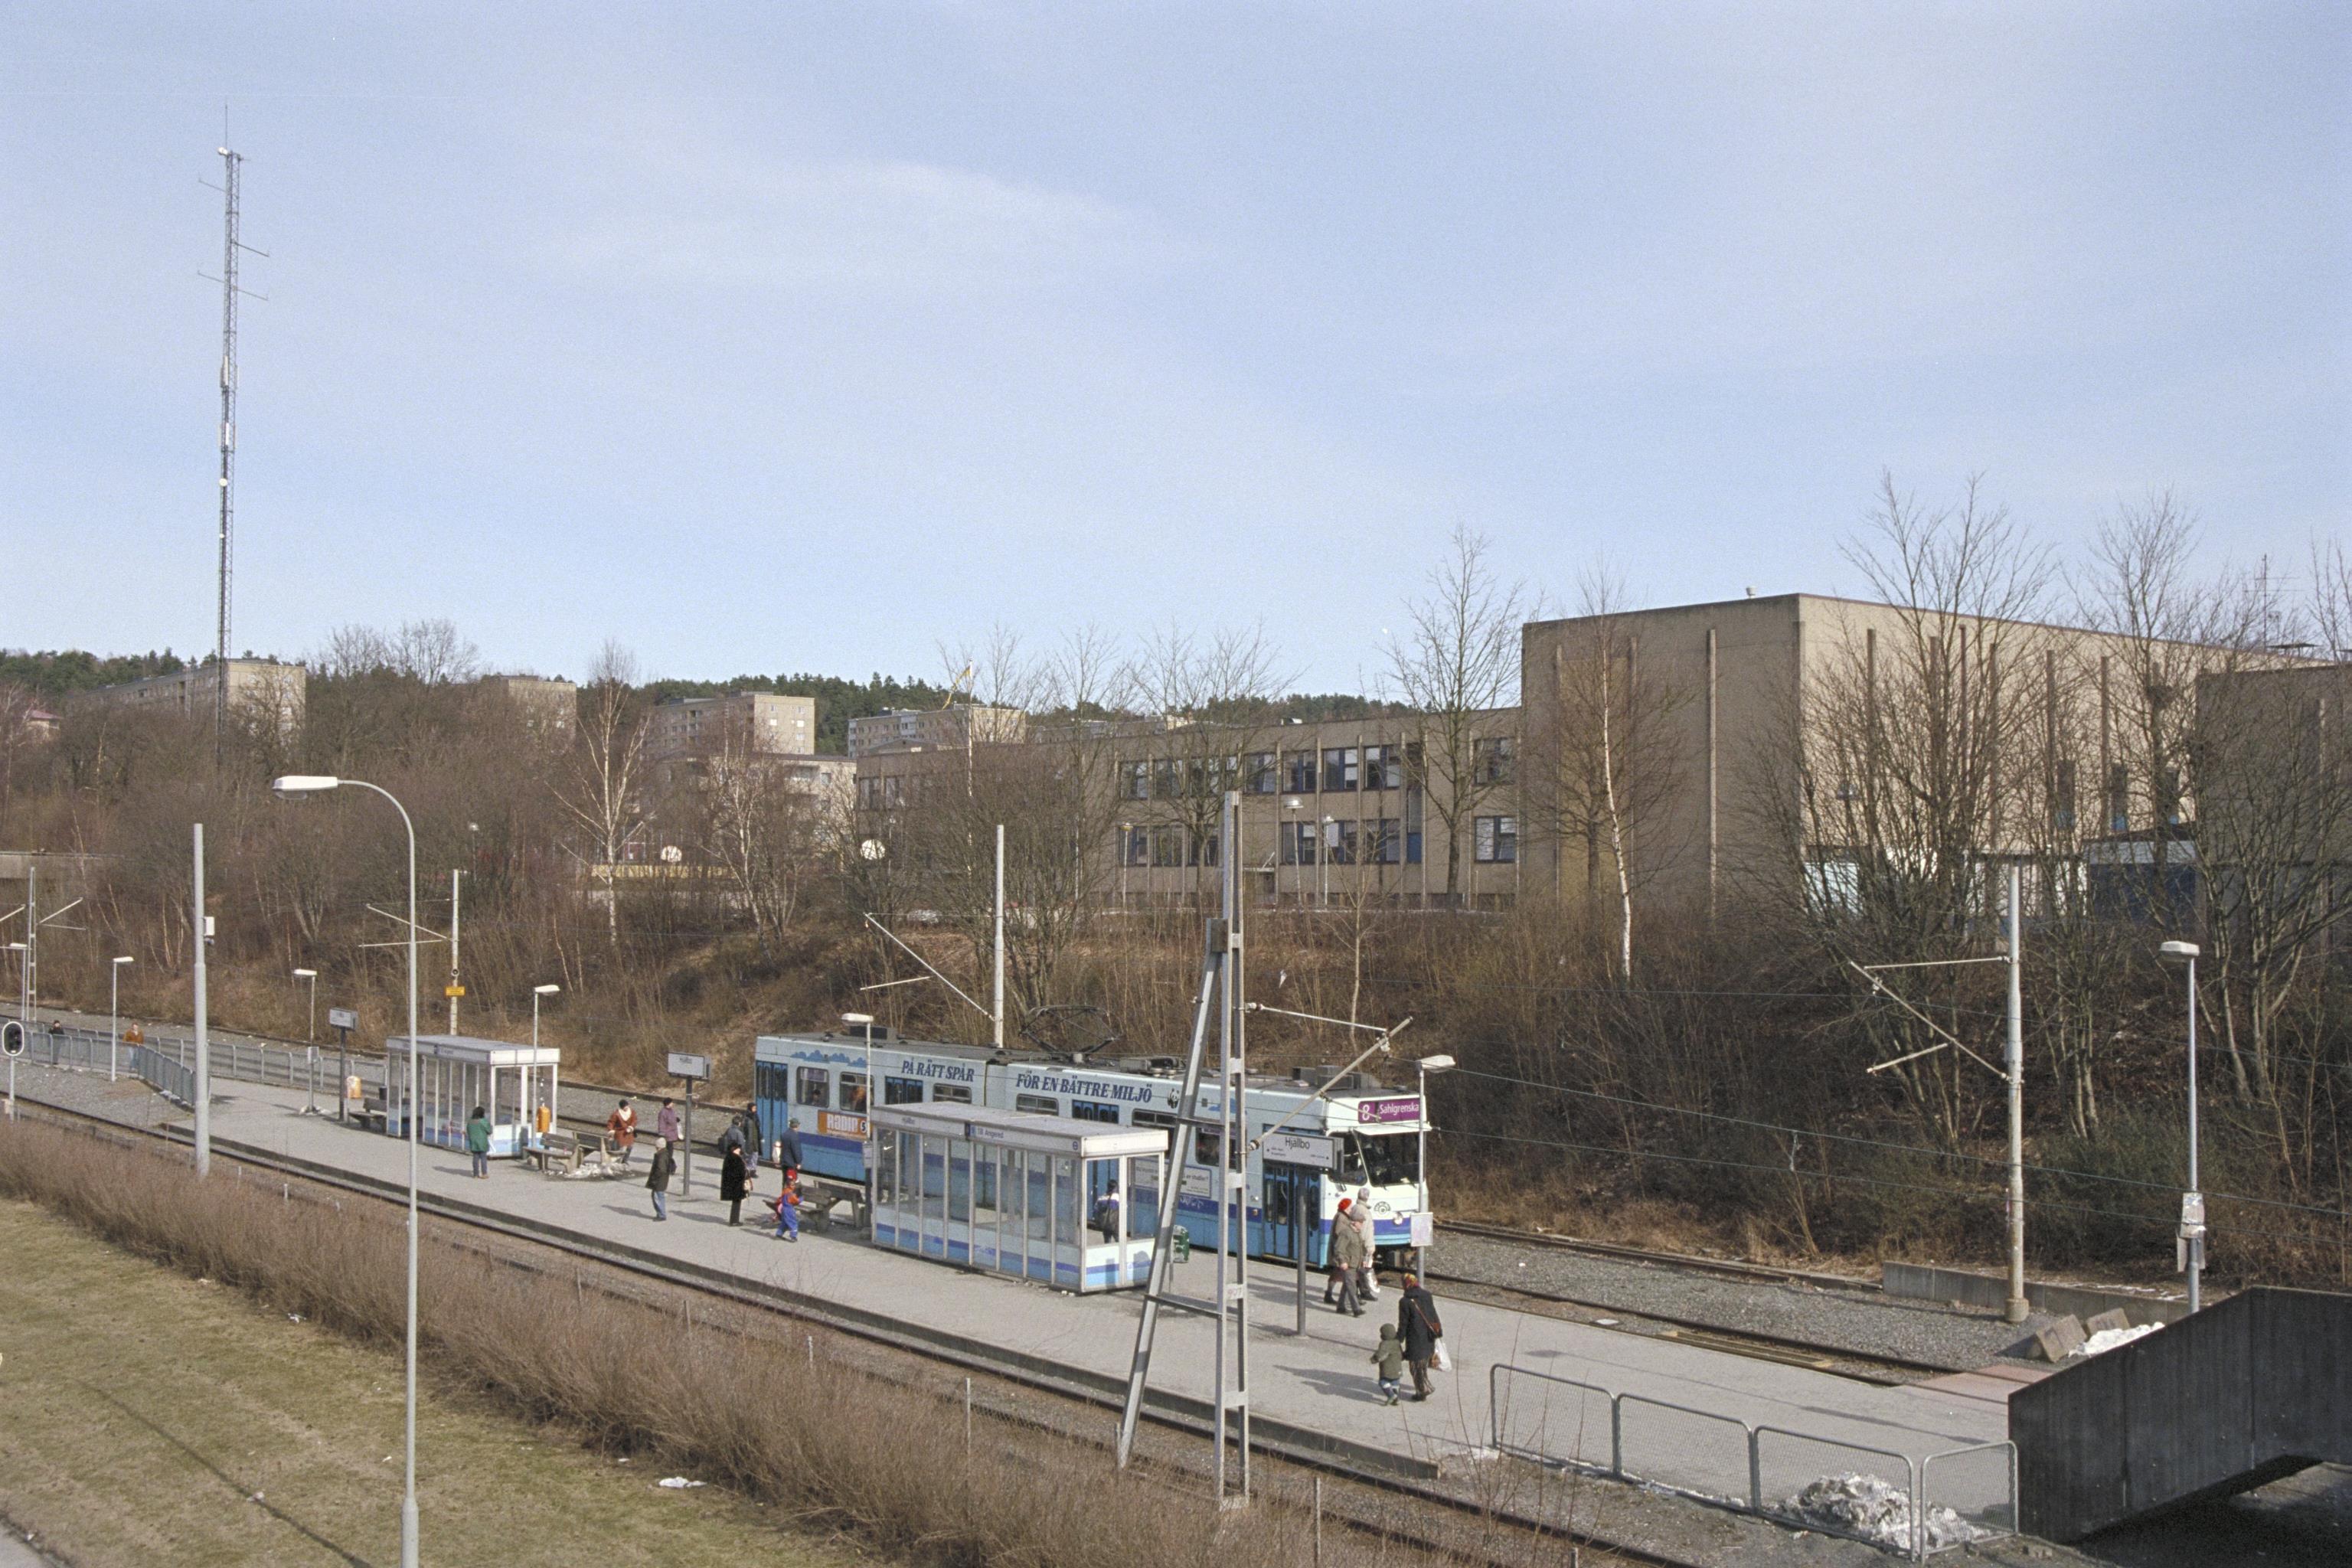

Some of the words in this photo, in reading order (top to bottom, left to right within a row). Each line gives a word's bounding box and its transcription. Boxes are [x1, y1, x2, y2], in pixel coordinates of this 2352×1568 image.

[902, 1057, 914, 1075] PÅ
[916, 1059, 946, 1078] RÄTT
[946, 1063, 975, 1082] SPÅR
[1016, 1071, 1040, 1089] FÖR
[1041, 1076, 1059, 1092] EN
[1060, 1075, 1110, 1098] BÄTTRE
[1110, 1083, 1152, 1103] MILJÖ
[1362, 1104, 1370, 1121] 8
[1379, 1102, 1419, 1116] Sahlgrenska
